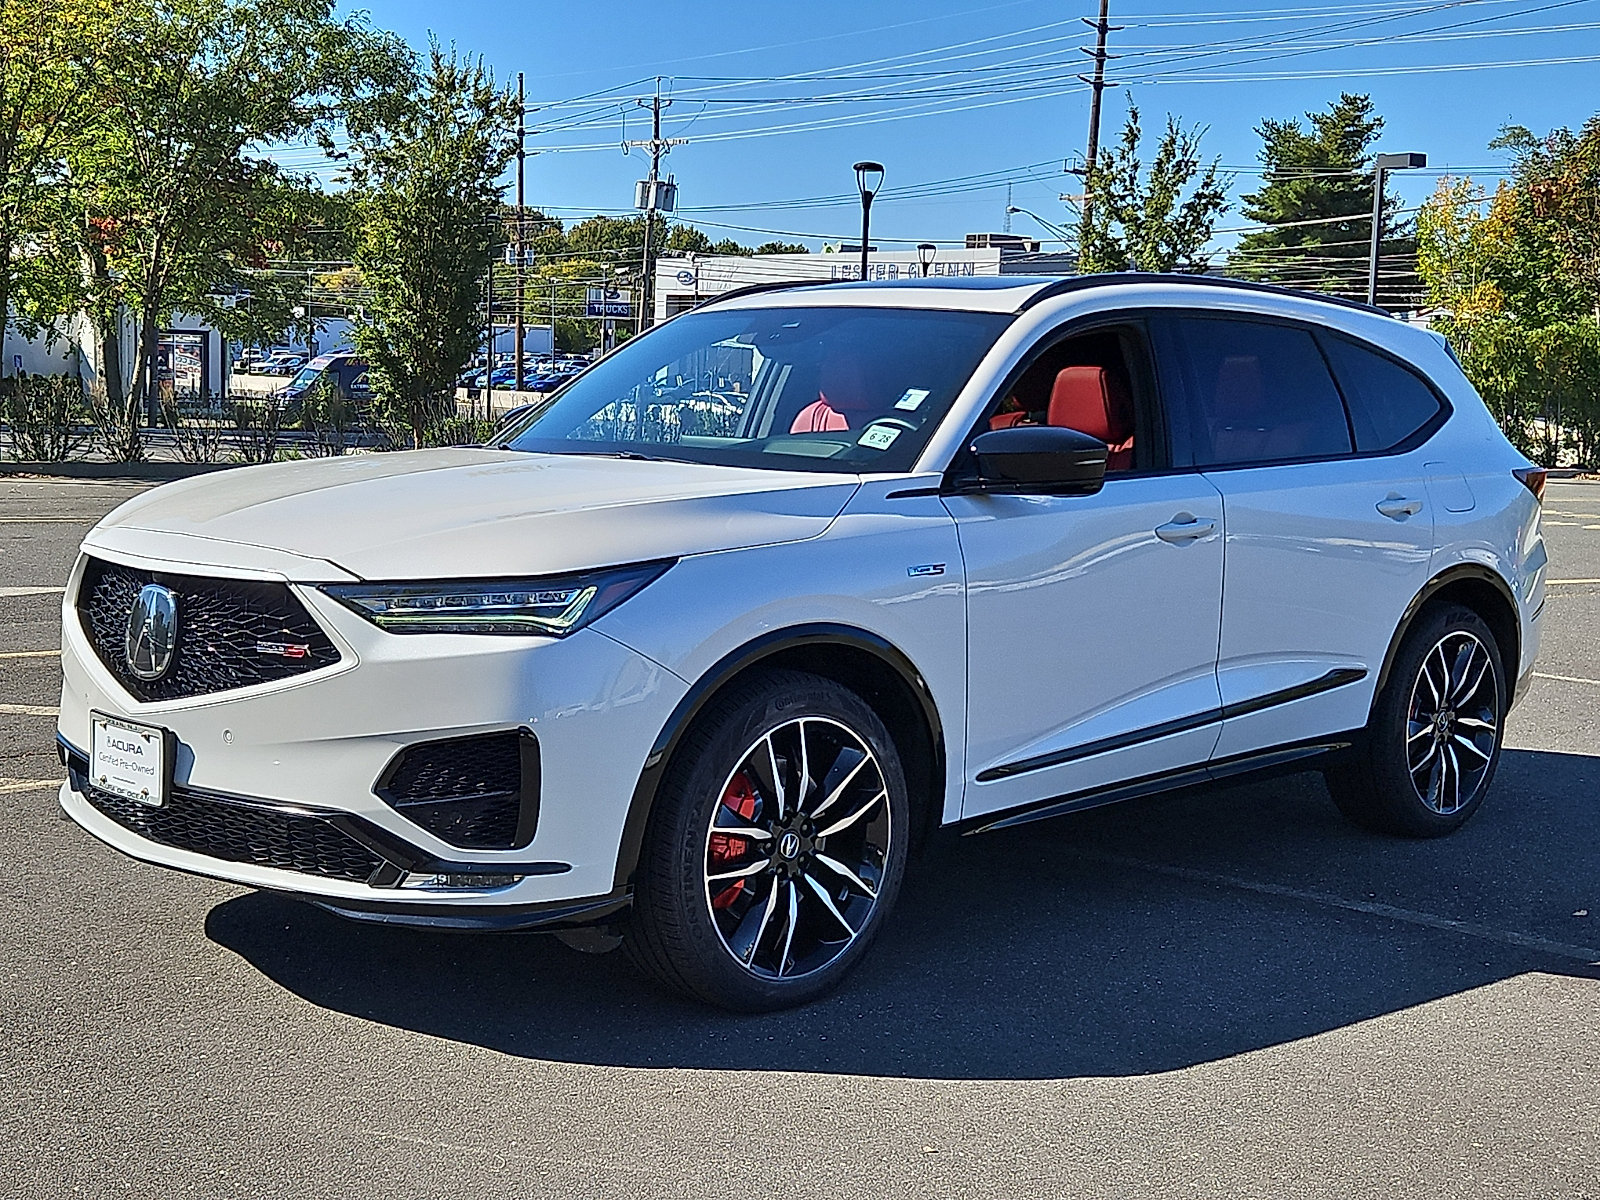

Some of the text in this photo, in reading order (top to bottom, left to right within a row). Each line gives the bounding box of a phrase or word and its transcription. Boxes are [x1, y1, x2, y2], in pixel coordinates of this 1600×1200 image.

[831, 261, 975, 281] LESTER GLENN
[593, 304, 628, 314] TRUCKS
[869, 432, 878, 441] 6
[111, 738, 144, 756] ACURA
[98, 751, 155, 776] Certified Pre-Owned
[126, 790, 150, 802] OCEAN
